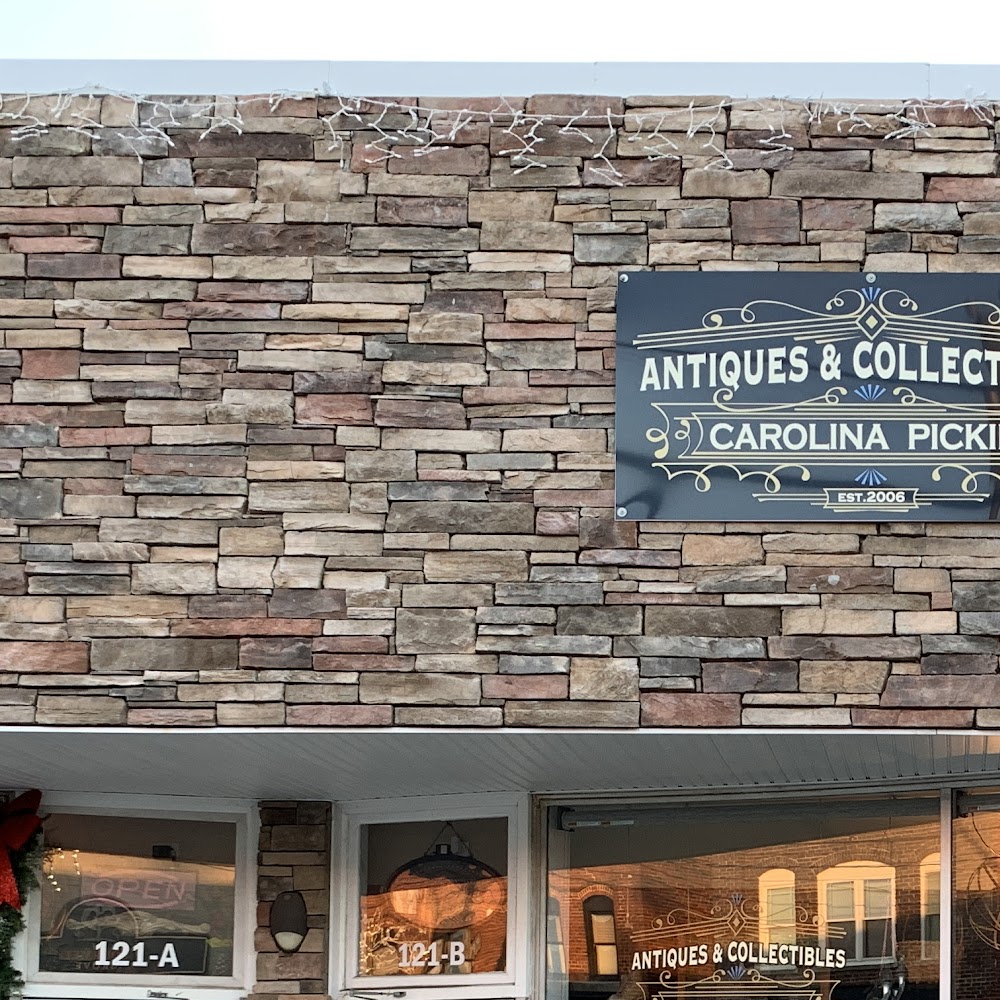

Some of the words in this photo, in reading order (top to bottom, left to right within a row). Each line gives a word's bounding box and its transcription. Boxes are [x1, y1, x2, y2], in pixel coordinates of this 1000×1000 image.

[640, 345, 809, 392] ANTIQUES
[820, 343, 842, 380] &
[709, 423, 889, 450] CAROLINA
[90, 878, 187, 901] OPEN
[94, 941, 180, 968] 121-A
[398, 941, 466, 968] 121-B
[631, 944, 708, 970] ANTIQUES
[712, 942, 723, 963] &
[727, 941, 847, 969] COLLECTIBLES
